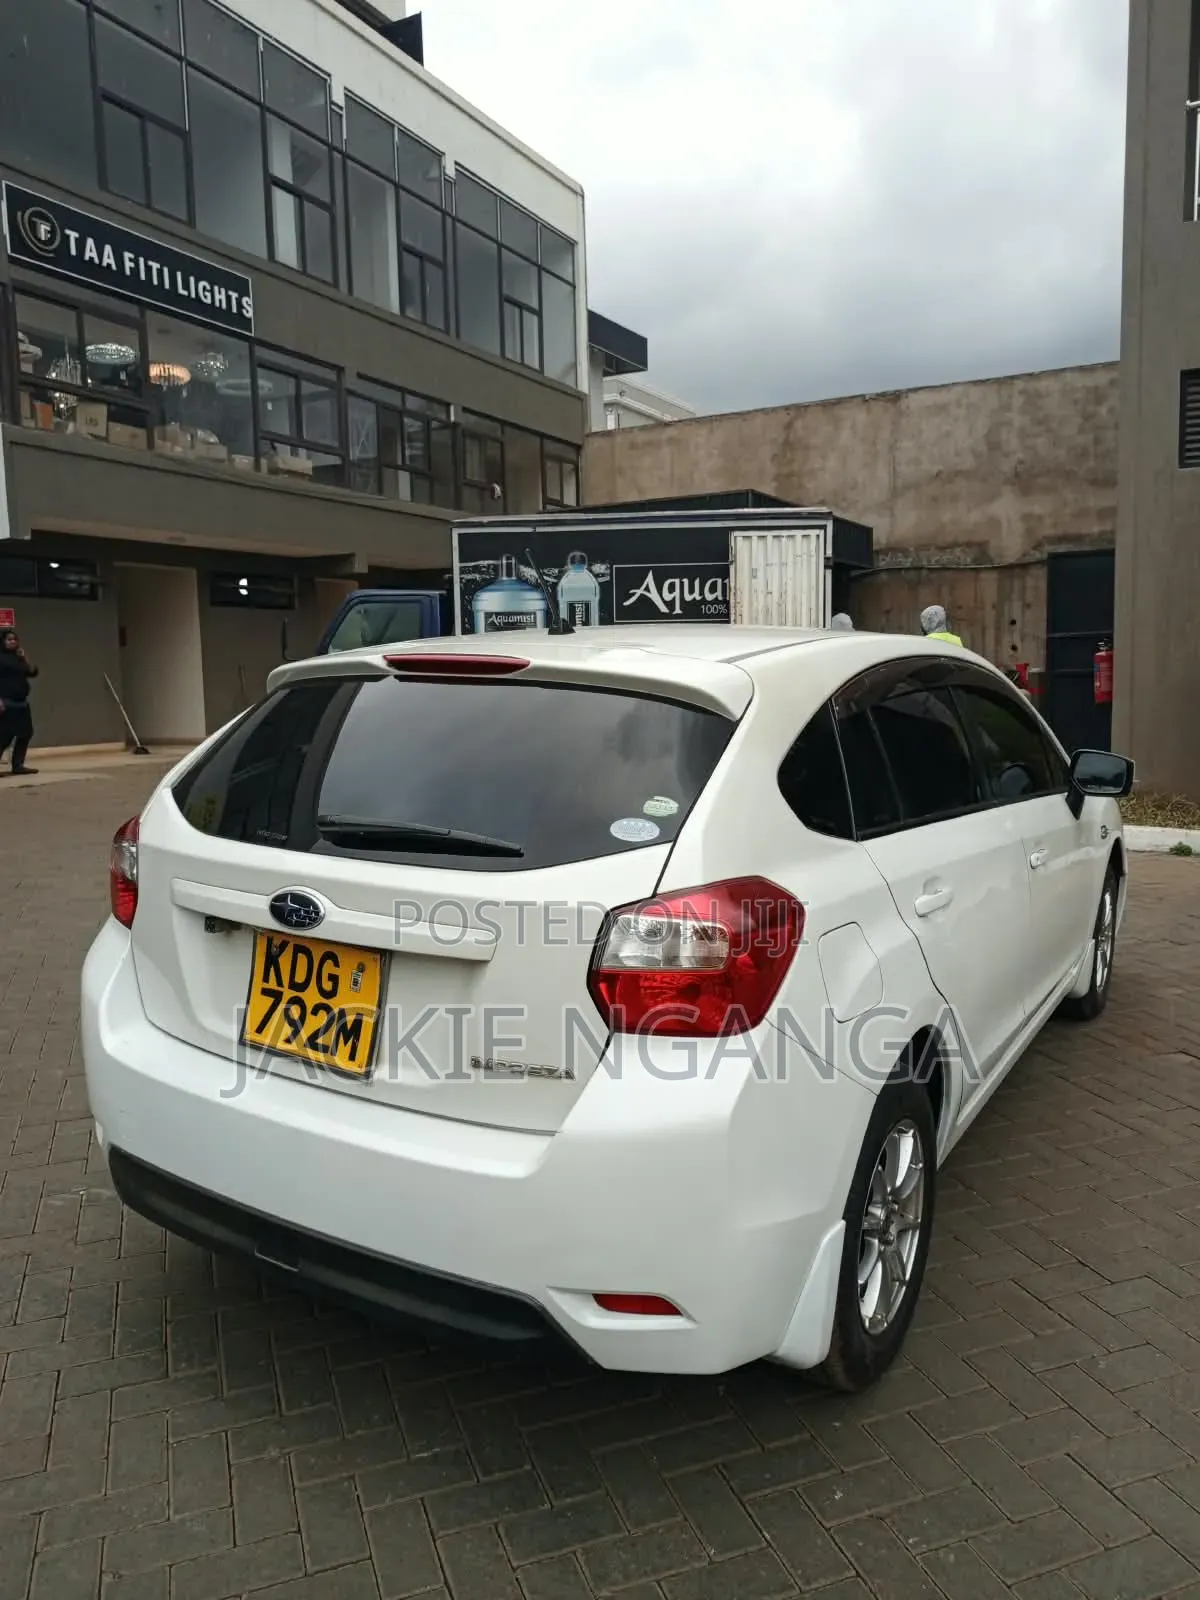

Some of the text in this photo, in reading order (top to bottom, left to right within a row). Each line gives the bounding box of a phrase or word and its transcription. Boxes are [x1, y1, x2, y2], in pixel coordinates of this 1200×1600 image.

[64, 229, 253, 318] TAA FITI LIGHTS
[487, 612, 535, 627] Aquamist
[701, 604, 728, 614] 100%
[262, 935, 340, 1000] KDG
[255, 987, 364, 1062] 792M
